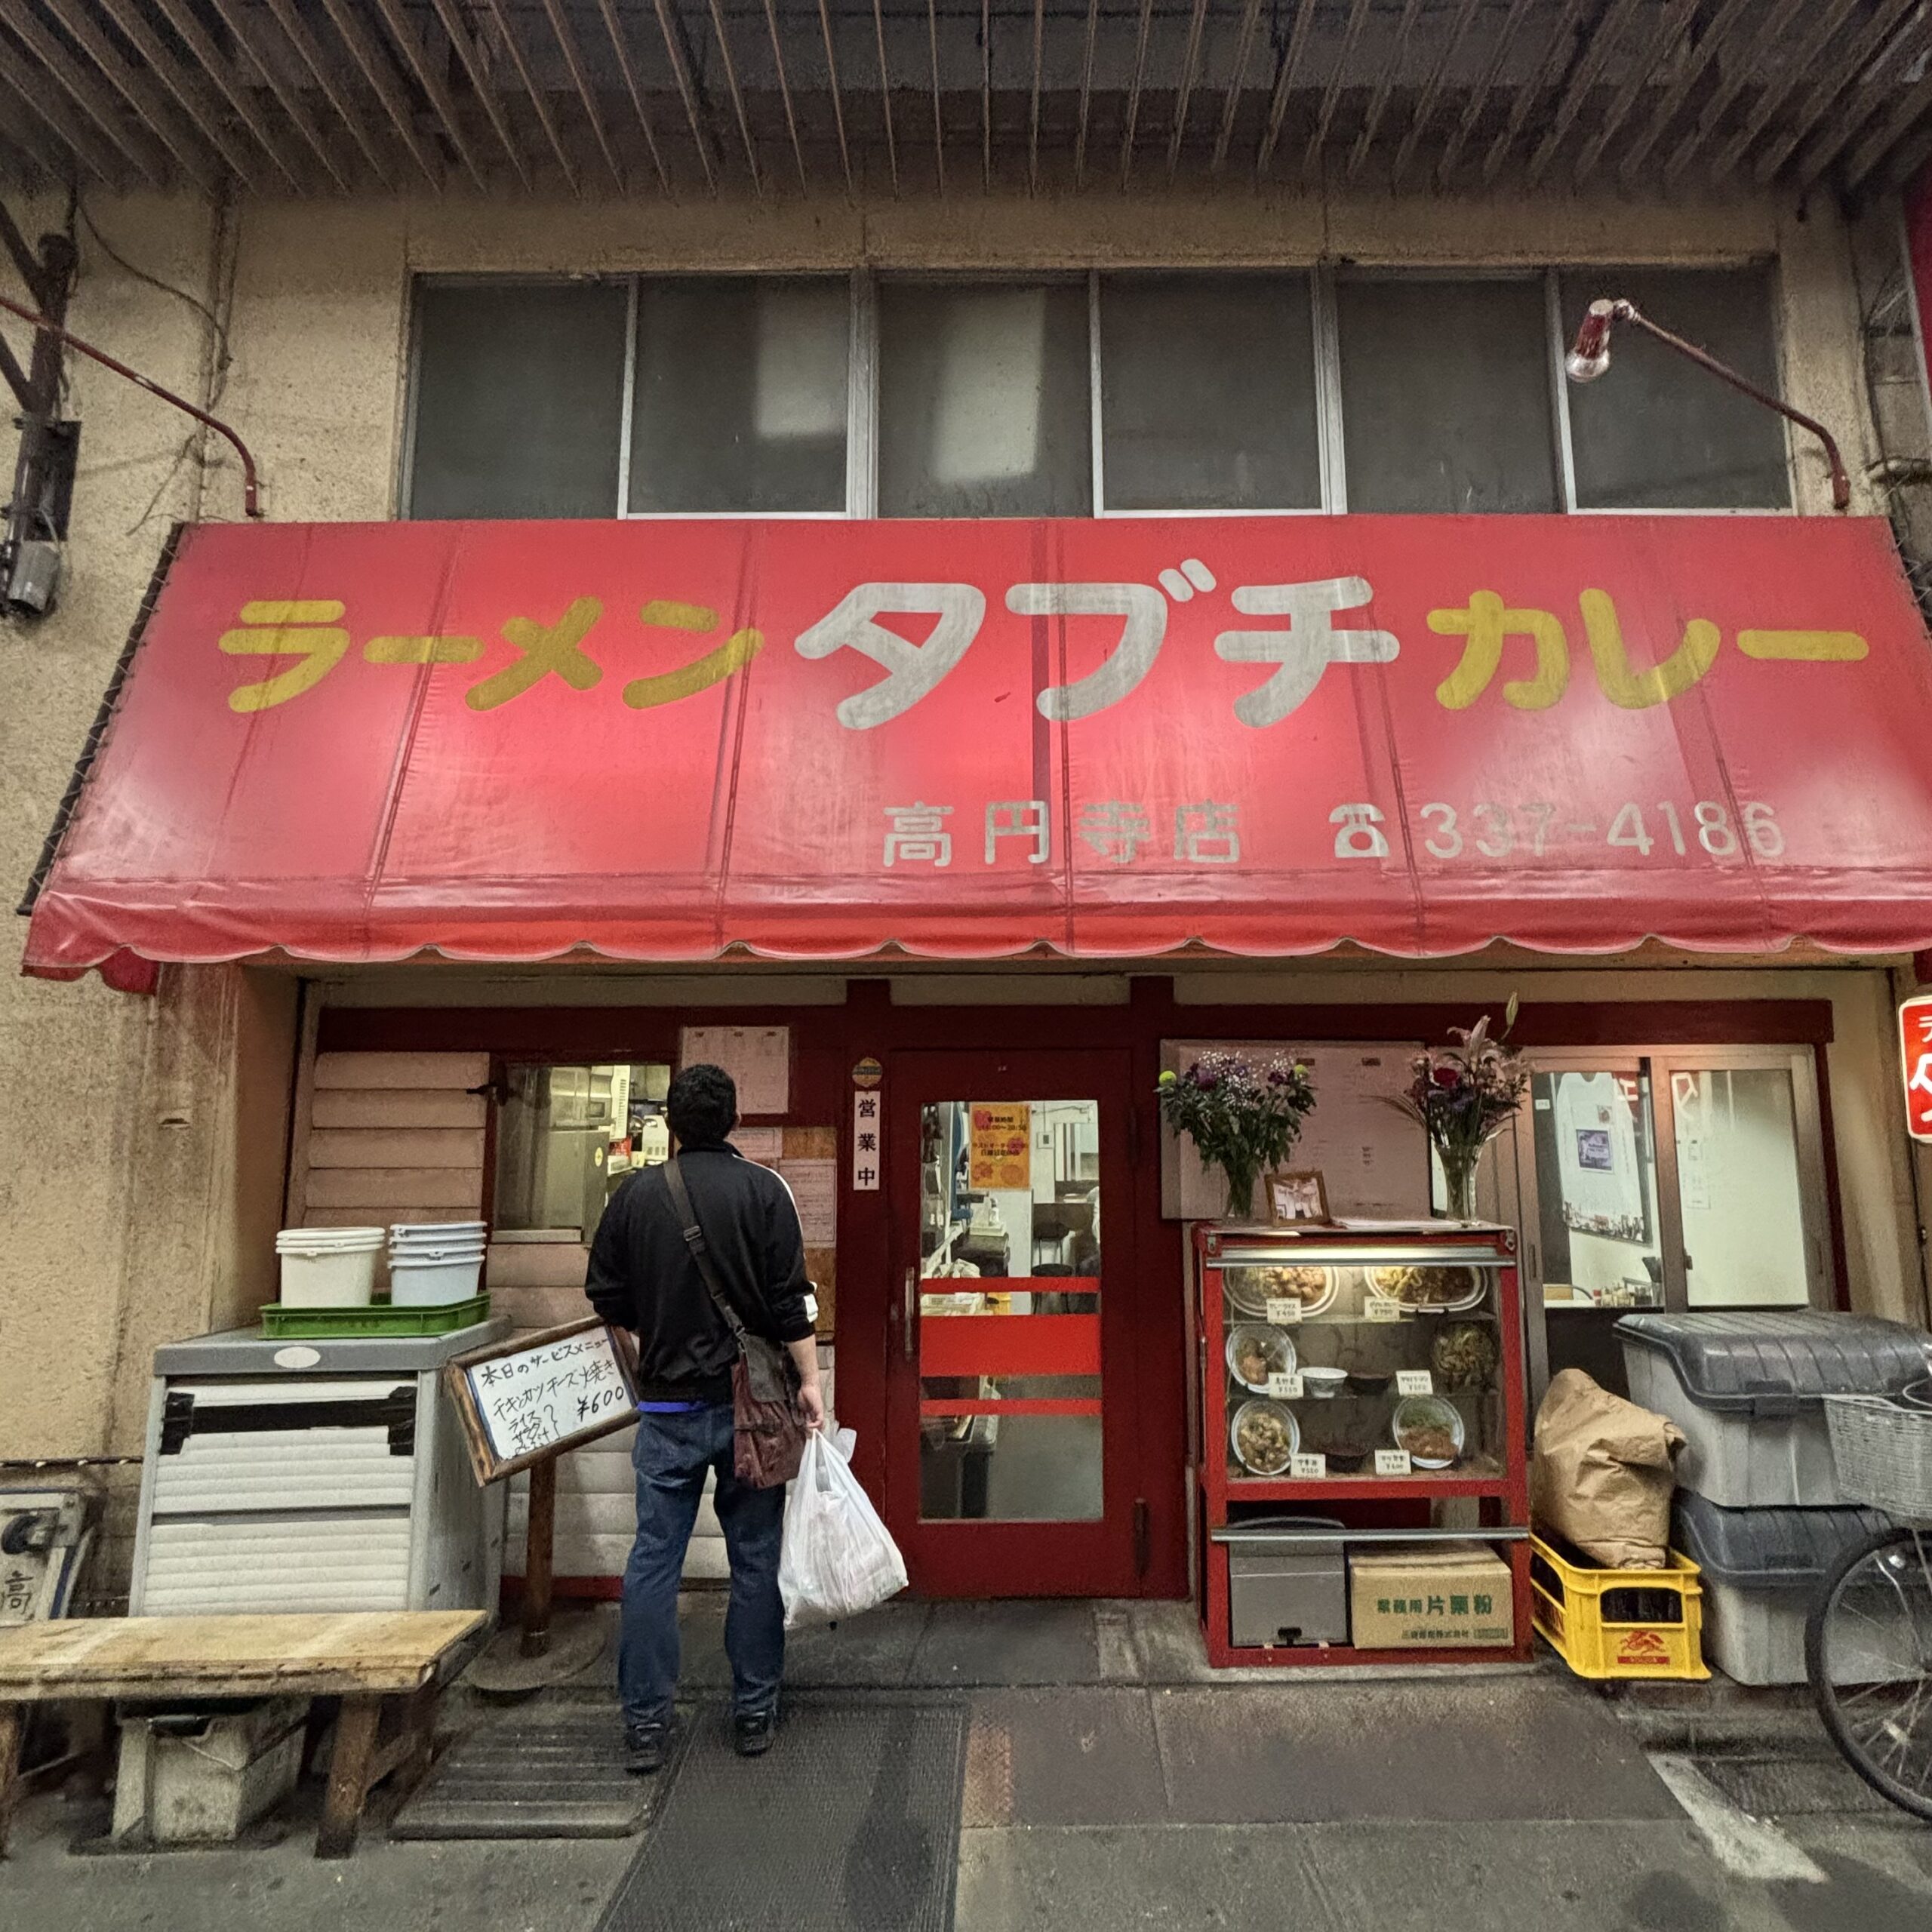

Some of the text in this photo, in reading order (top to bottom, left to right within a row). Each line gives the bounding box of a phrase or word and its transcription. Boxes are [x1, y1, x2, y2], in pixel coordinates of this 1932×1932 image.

[219, 558, 1870, 731] ラーメン タブチ カレー
[882, 801, 1241, 867] 高円寺店
[1419, 800, 1786, 859] 337-4186
[857, 1099, 876, 1186] 営業中
[481, 1337, 608, 1387] 本日のサービスメニュー
[508, 1386, 625, 1433] ライス ¥600
